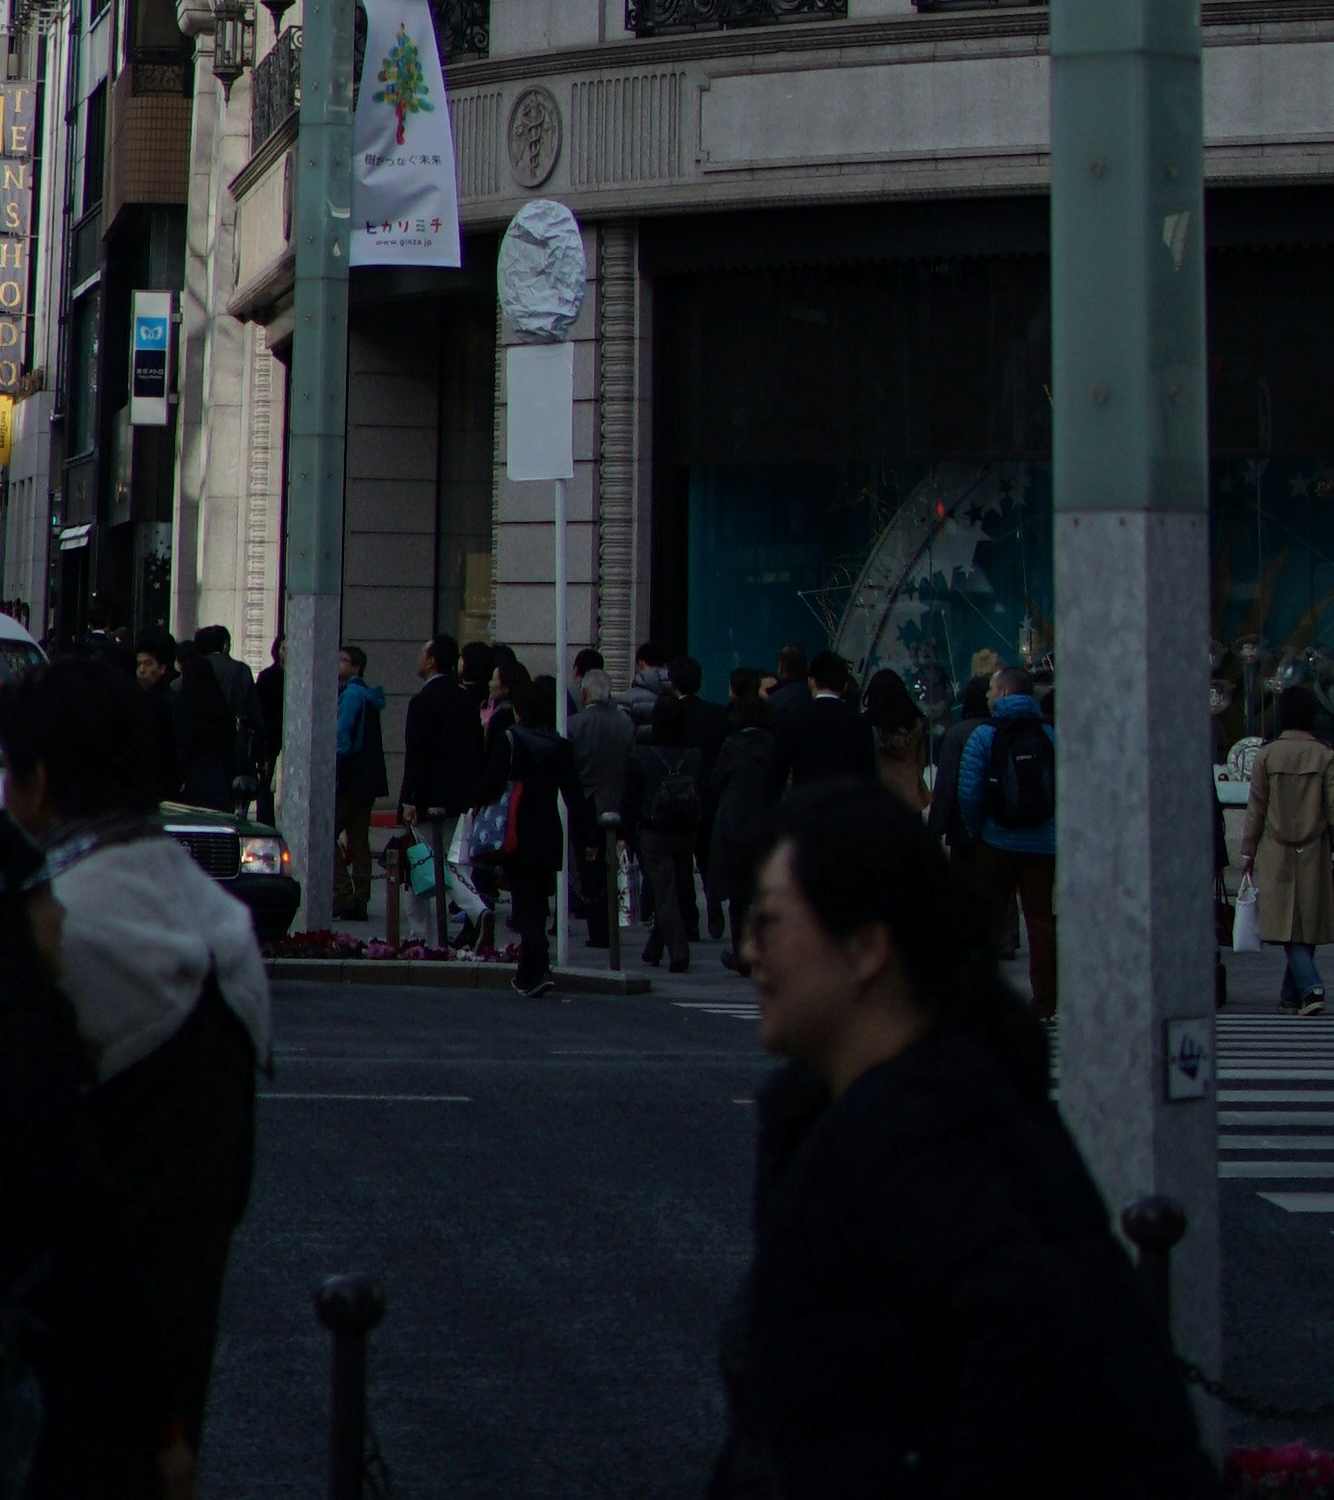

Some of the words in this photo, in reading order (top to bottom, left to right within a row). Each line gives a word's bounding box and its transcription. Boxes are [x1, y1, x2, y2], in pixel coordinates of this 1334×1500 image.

[366, 217, 442, 234] ヒカリミチ
